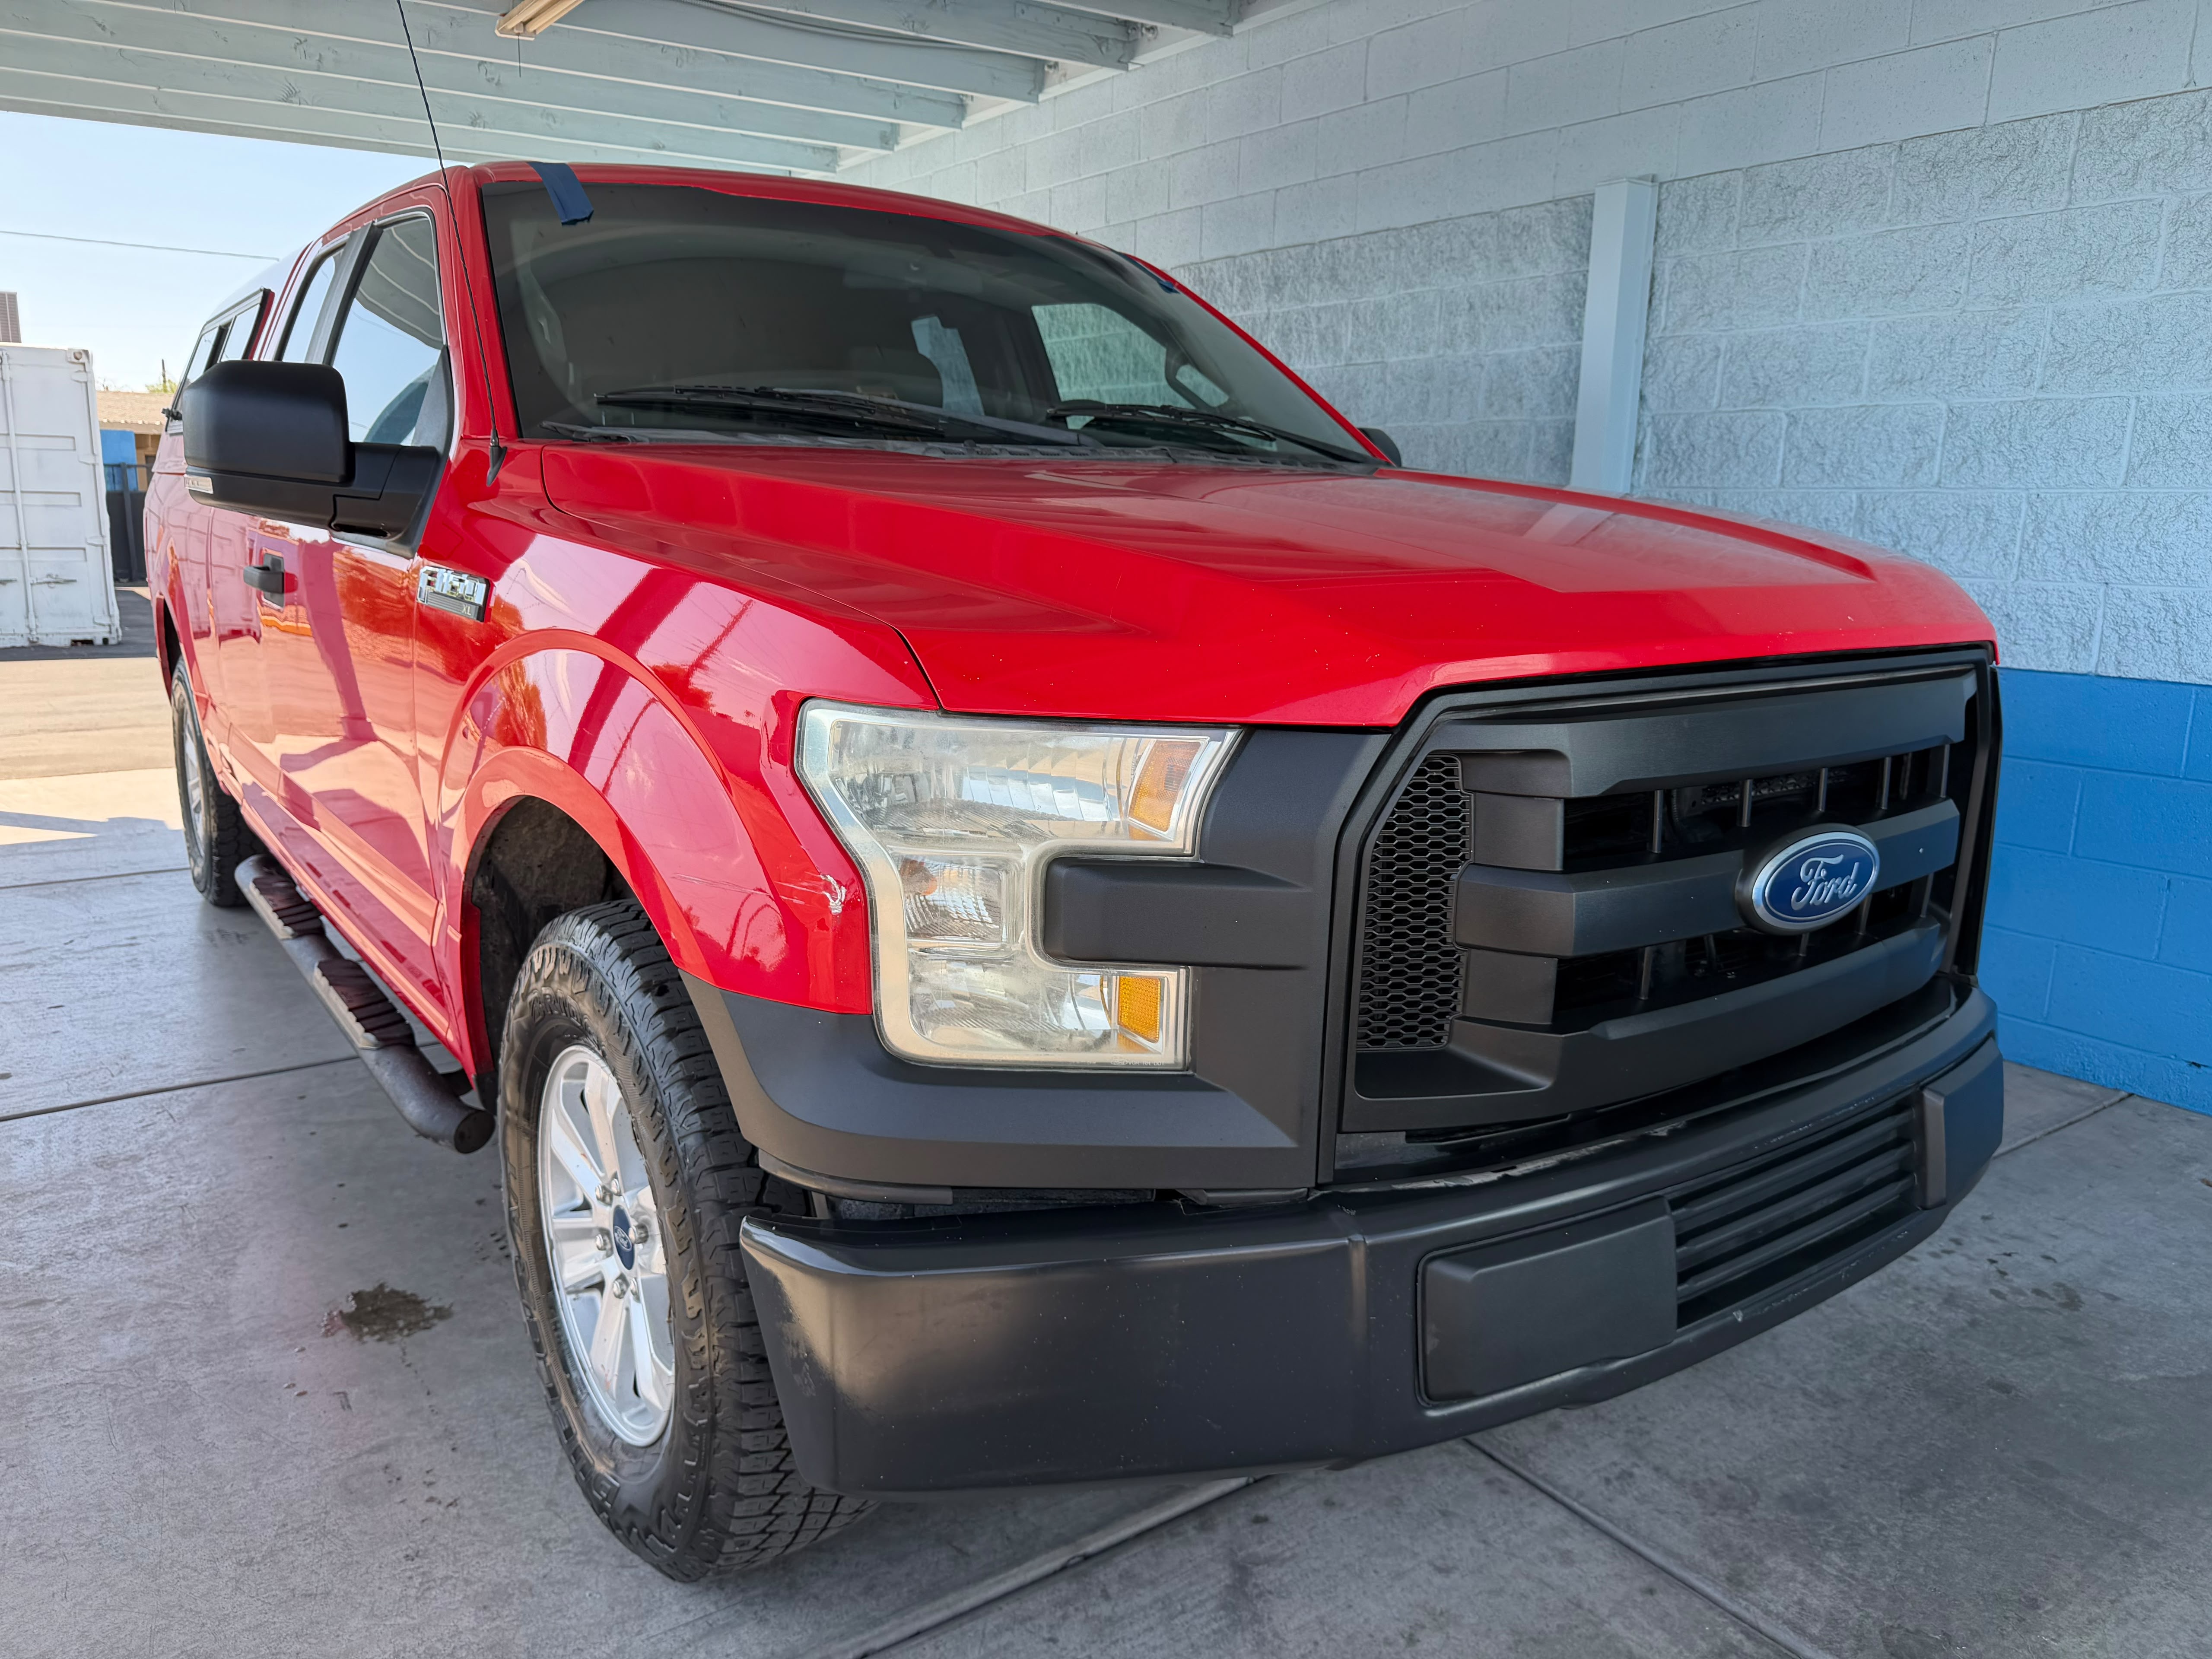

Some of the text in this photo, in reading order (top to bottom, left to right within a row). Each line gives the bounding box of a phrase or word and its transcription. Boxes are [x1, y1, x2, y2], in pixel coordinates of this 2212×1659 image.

[462, 604, 471, 616] XL
[1791, 854, 1860, 911] Ford
[614, 1228, 628, 1248] Ford
